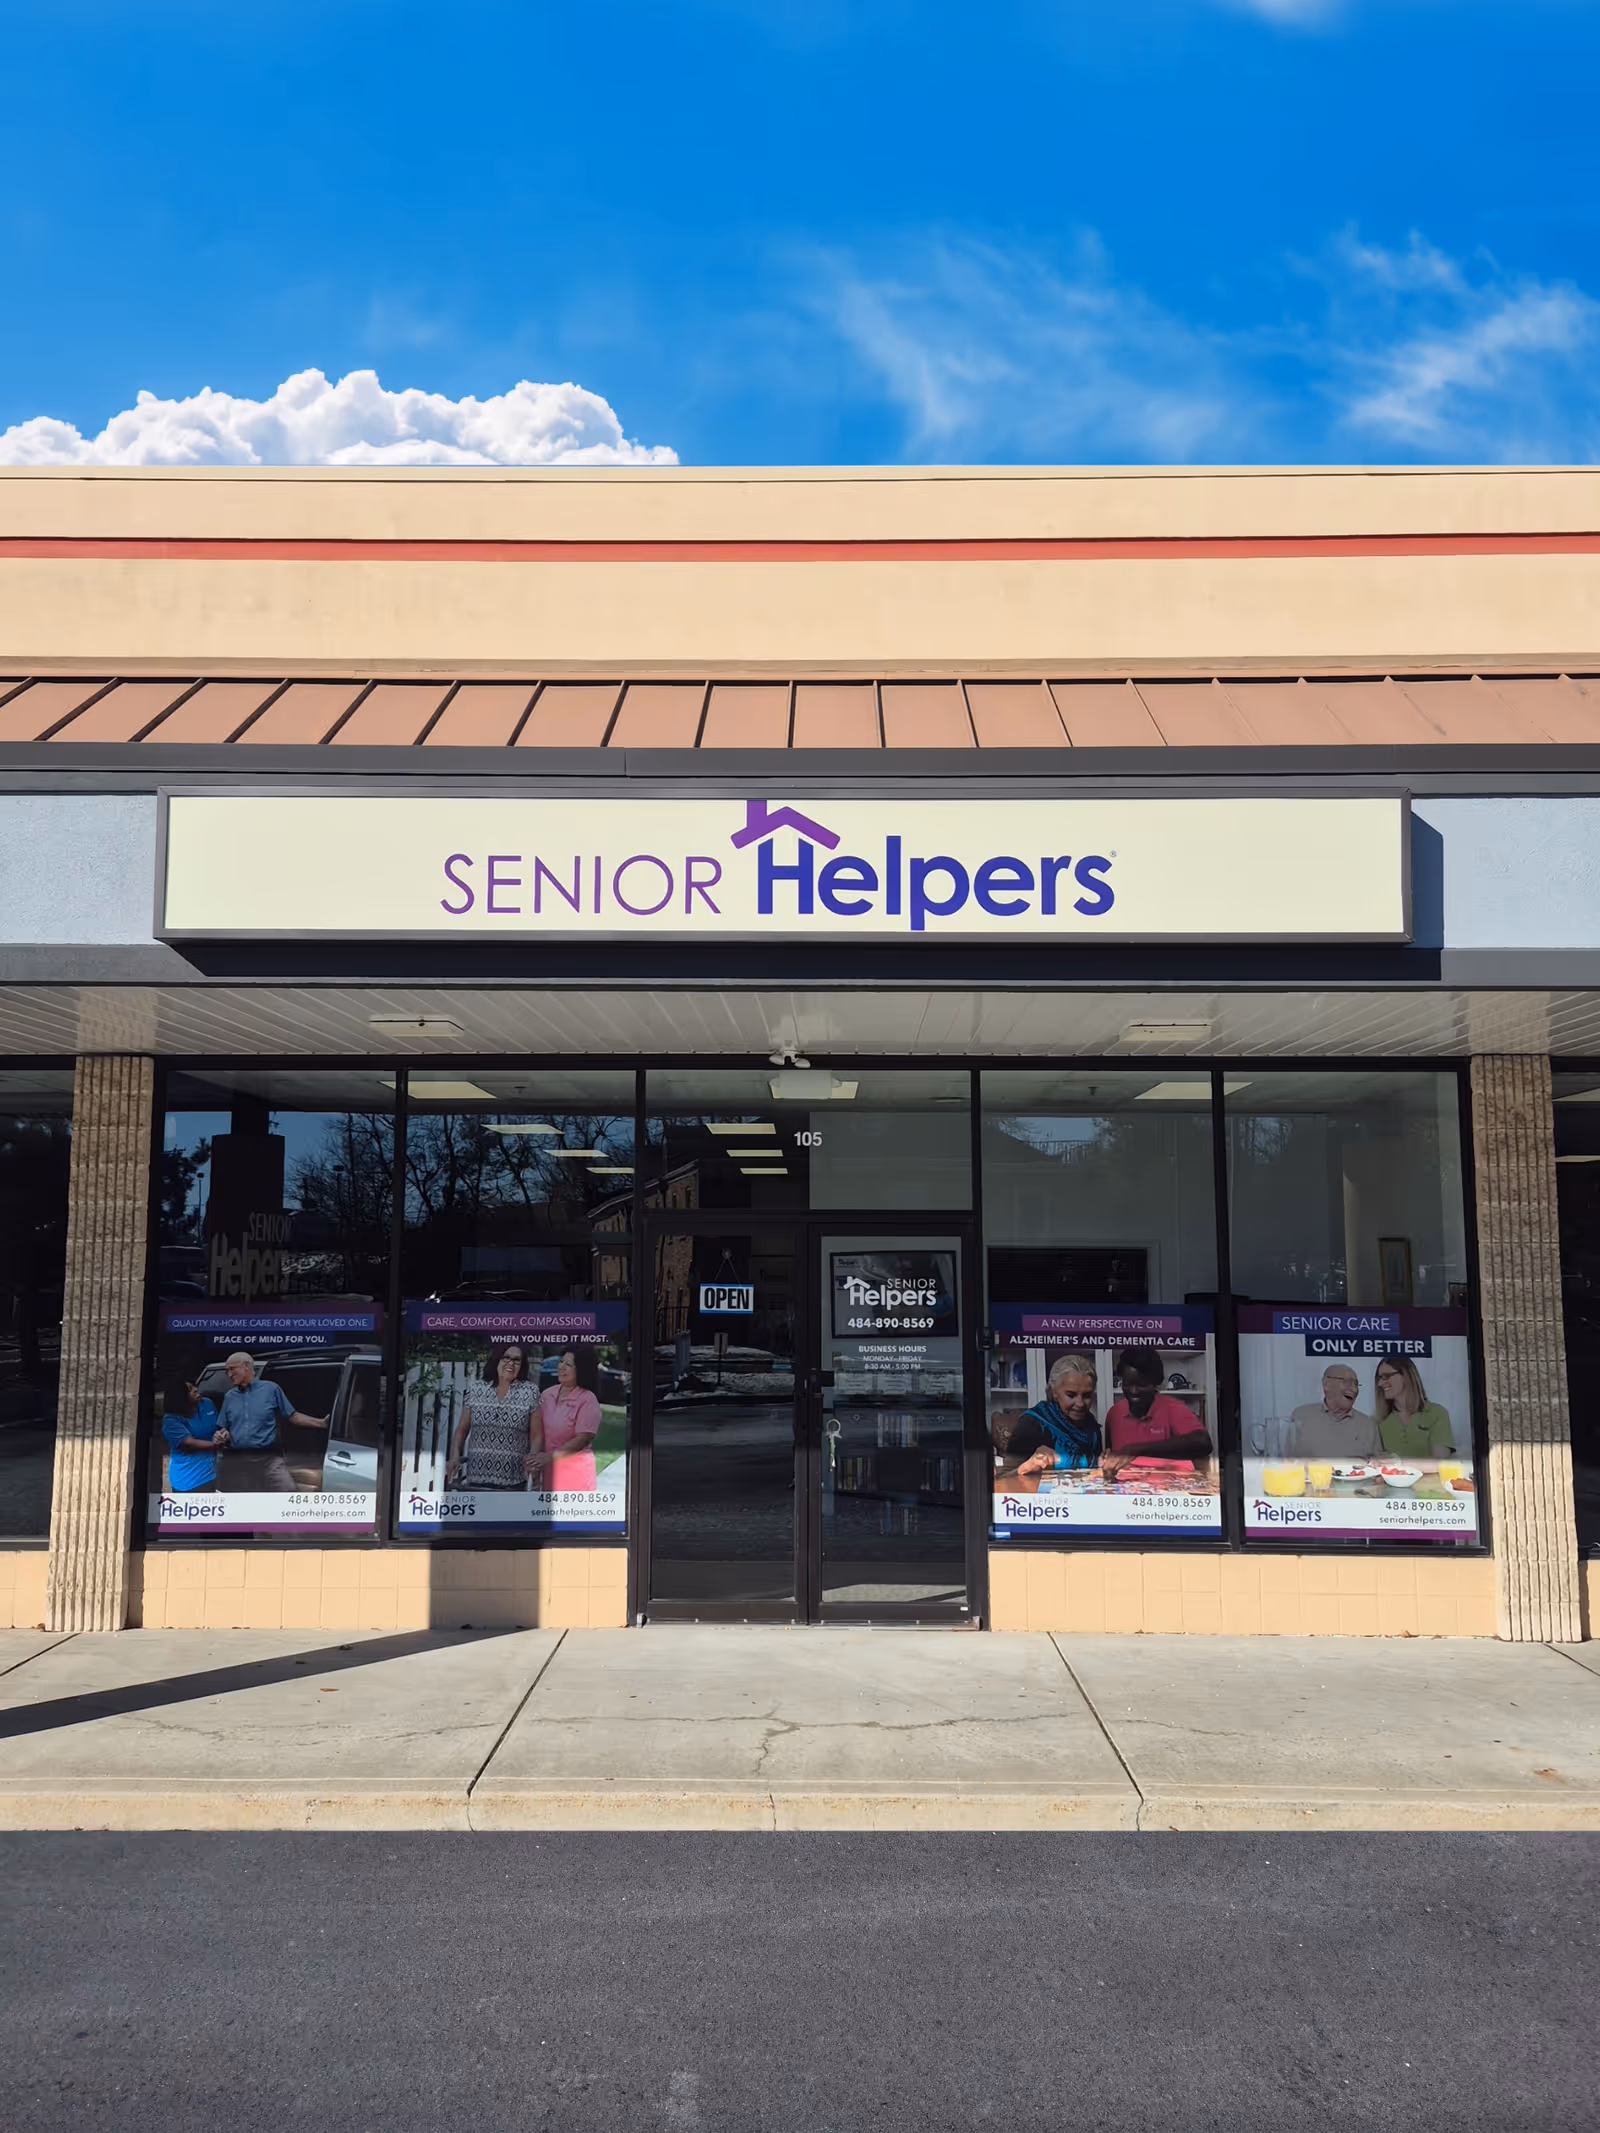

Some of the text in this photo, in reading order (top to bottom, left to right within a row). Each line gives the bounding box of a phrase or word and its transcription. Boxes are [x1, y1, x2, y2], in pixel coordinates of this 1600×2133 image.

[440, 834, 1116, 931] SENIOR Helpers
[793, 1131, 823, 1147] 105
[249, 1211, 290, 1242] SENIO
[886, 1278, 937, 1289] SENIOR
[704, 1287, 750, 1310] OPEN
[849, 1284, 938, 1311] Helpers
[171, 1318, 369, 1328] QUALITY IN-HOME CARE FOR YOUR LOVED ONE
[427, 1316, 591, 1328] CARE, COMFORT, COMPASSION
[847, 1317, 935, 1329] 484-890-8569
[1041, 1318, 1163, 1329] A NEW PERSPECTIVE ON
[1281, 1316, 1391, 1331] SENIOR CARE
[213, 1335, 327, 1344] PEACE OF MIND FOR YOU.
[490, 1335, 609, 1343] WHEN YOU NEED IT MOST.
[1009, 1335, 1196, 1346] ALZHEIMER'S AND DEMENTIA CARE
[858, 1345, 927, 1353] BUSINESS HOURS
[1312, 1338, 1425, 1354] ONLY BETTER
[188, 1496, 226, 1505] SENIOR
[287, 1494, 367, 1505] 484.890.8569
[440, 1495, 476, 1504] SENIOR
[537, 1493, 616, 1504] 484.890.8569
[1131, 1497, 1212, 1508] 484.890.8569
[161, 1502, 226, 1521] Helpers
[412, 1500, 476, 1520] Helpers
[1006, 1502, 1070, 1521] Helpers
[1385, 1500, 1466, 1512] 484.890.8569
[280, 1508, 367, 1519] seniorhelpers.com
[531, 1506, 616, 1518] seniorhelpers.com
[1125, 1511, 1212, 1522] seniorhelpers.com
[1257, 1505, 1322, 1525] Helpers
[1379, 1515, 1467, 1526] seniorhelpers.com
